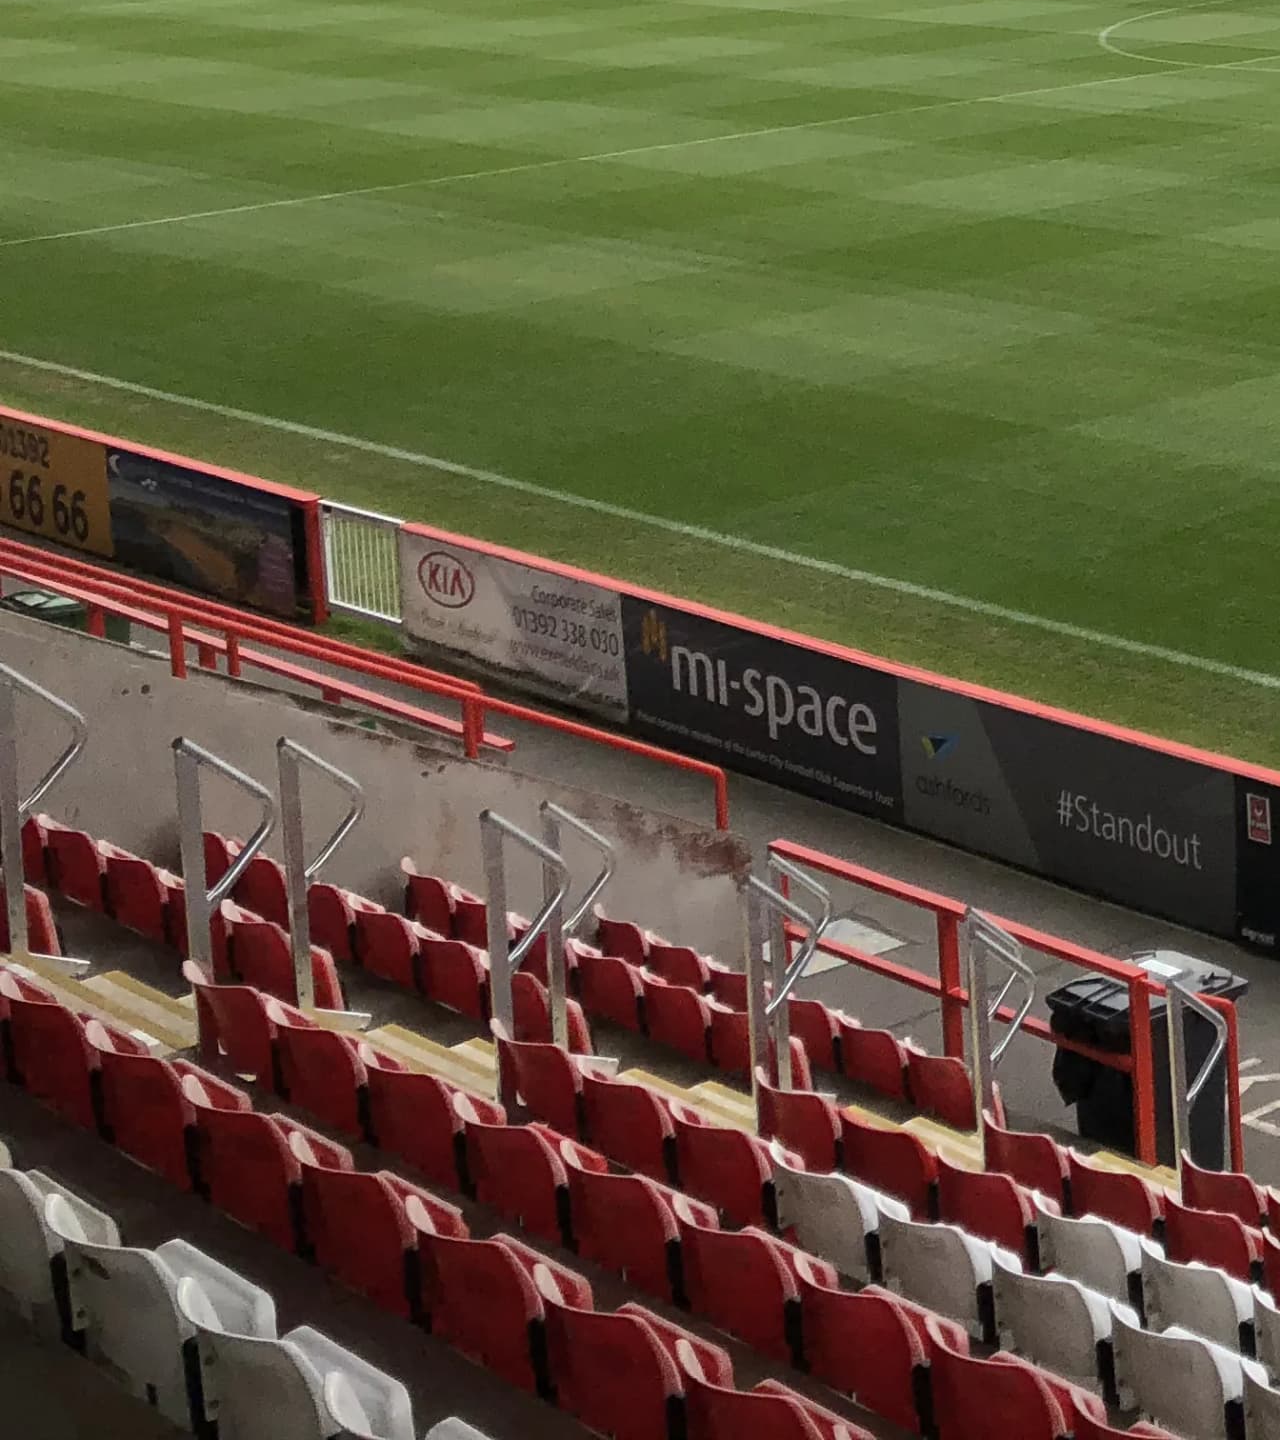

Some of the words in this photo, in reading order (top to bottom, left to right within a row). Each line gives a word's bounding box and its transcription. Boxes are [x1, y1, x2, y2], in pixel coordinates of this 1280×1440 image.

[0, 421, 50, 469] 1392
[9, 469, 44, 527] 66
[53, 483, 89, 543] 66
[428, 561, 466, 599] KIA
[530, 585, 587, 615] Corporate
[588, 599, 618, 624] Sales
[512, 606, 557, 637] 01392
[561, 619, 587, 648] 338
[590, 628, 619, 657] 030
[1057, 789, 1202, 869] #Standout
